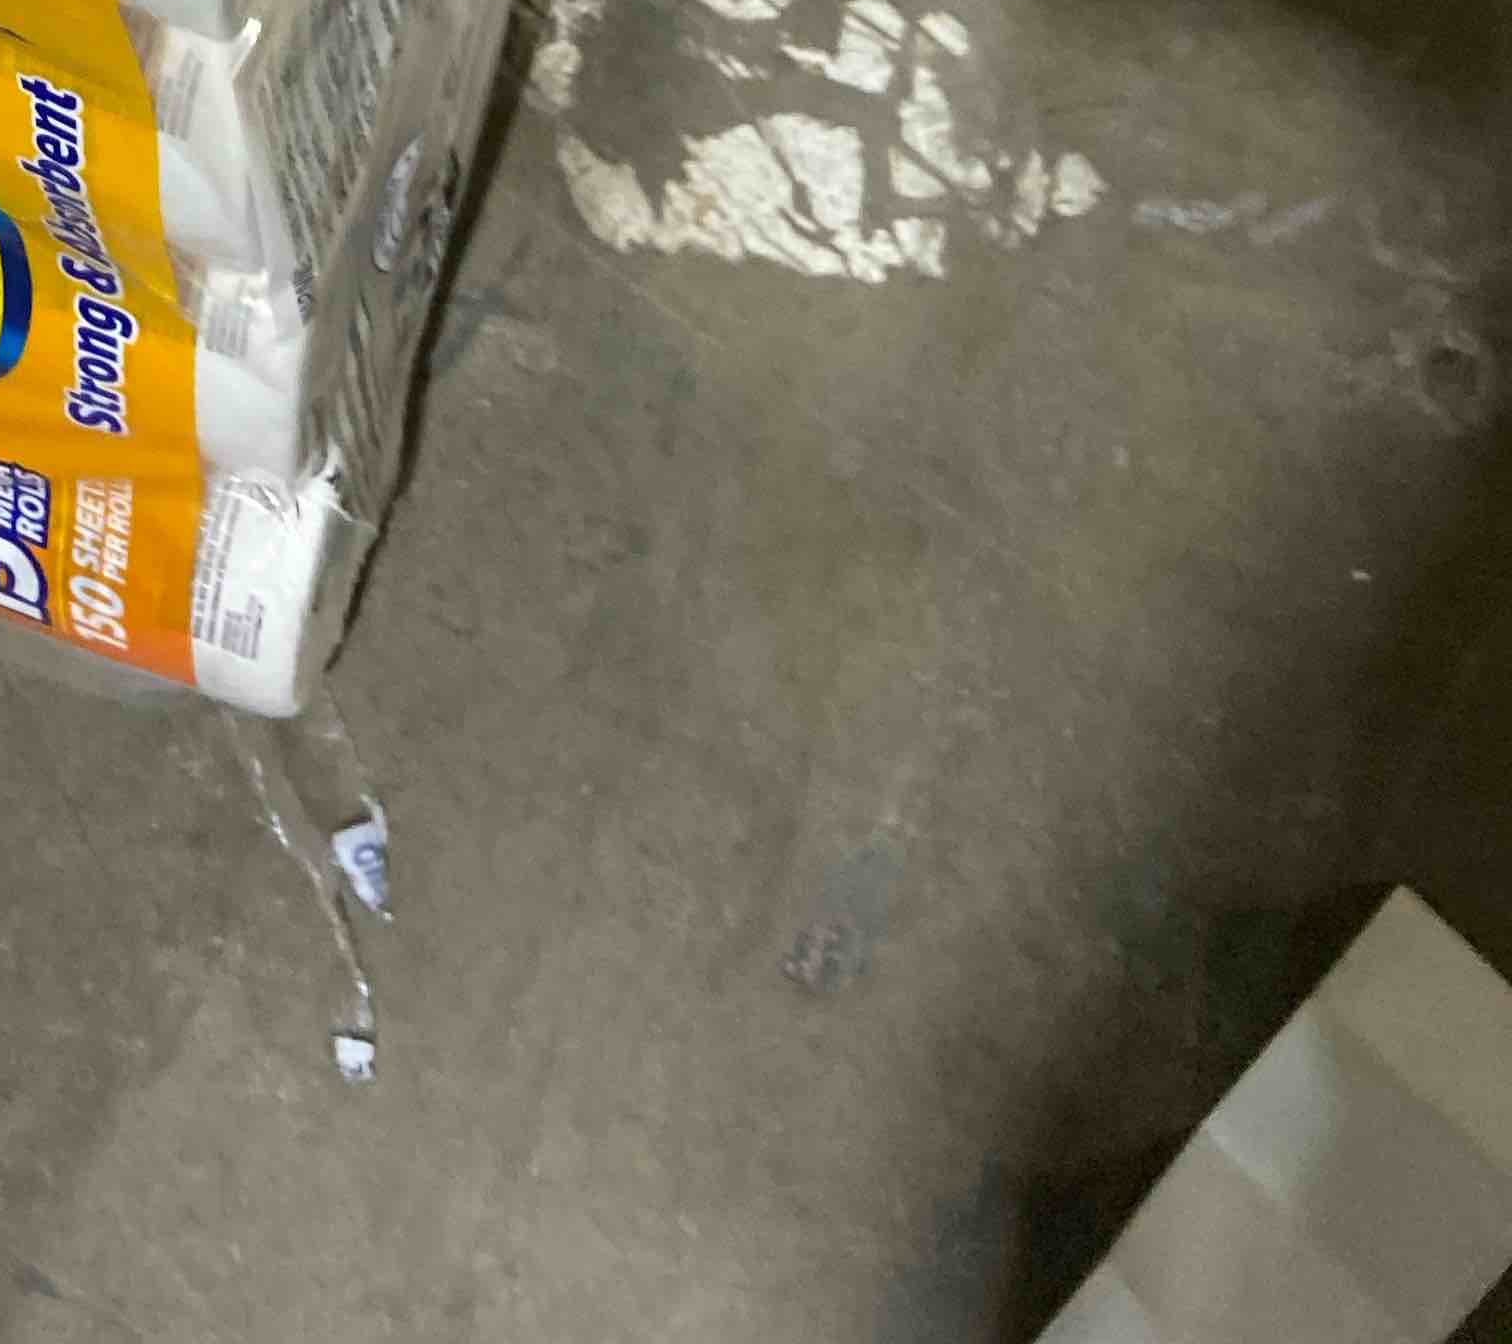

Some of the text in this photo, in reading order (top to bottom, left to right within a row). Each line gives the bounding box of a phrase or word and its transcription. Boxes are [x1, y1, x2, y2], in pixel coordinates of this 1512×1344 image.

[61, 253, 136, 435] Strong &
[101, 541, 130, 586] PER
[69, 580, 129, 651] 150
